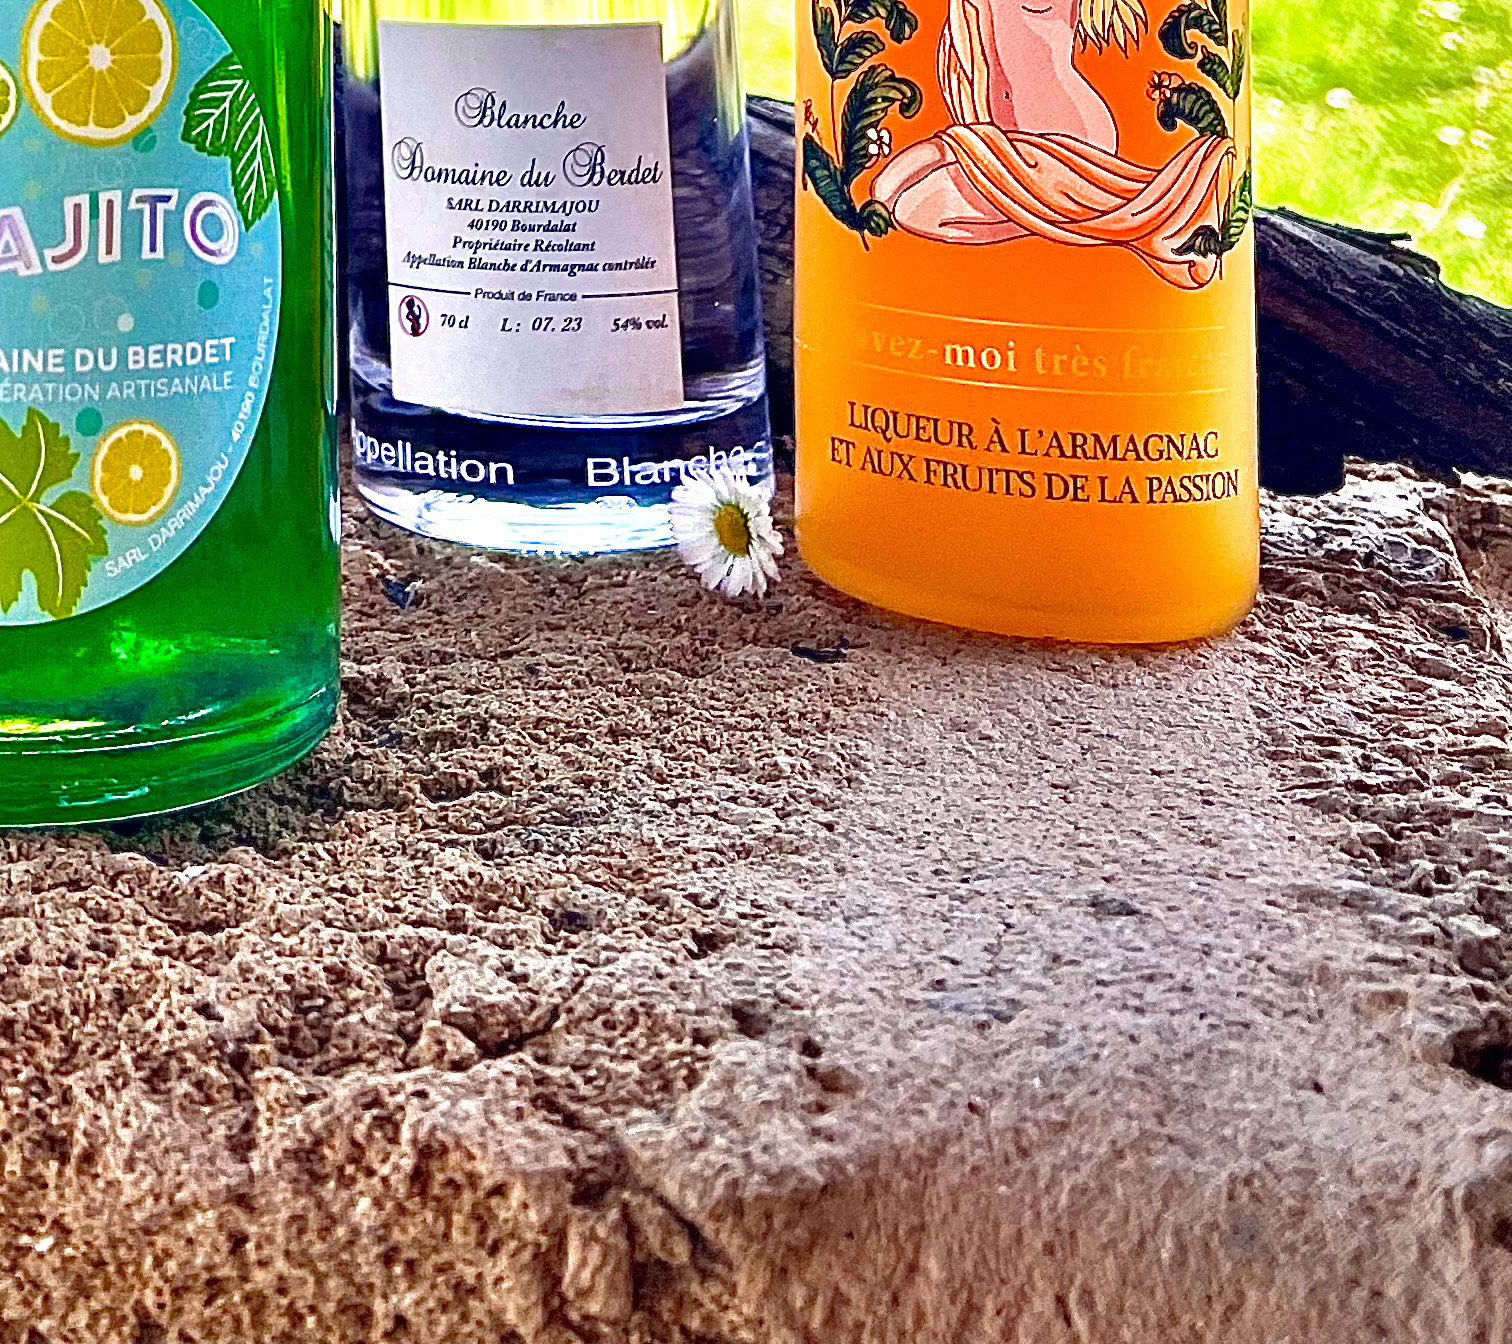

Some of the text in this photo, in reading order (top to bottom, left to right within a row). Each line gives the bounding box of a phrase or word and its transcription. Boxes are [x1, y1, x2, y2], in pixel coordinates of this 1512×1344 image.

[454, 86, 587, 130] Blanche
[391, 136, 663, 188] Domaine du Berdet
[446, 197, 600, 216] SARL DARRIMAJOU
[467, 218, 578, 233] 40190 Bourdalat
[452, 235, 596, 255] Propriétaire Récoltant
[402, 250, 465, 270] Appellation
[467, 257, 516, 272] Blanche
[520, 258, 599, 277] d'Armagnac
[474, 288, 577, 302] Produit de France
[440, 313, 456, 328] 70
[610, 316, 642, 332] 54%
[75, 346, 117, 373] DU
[127, 336, 237, 371] BERDET
[1035, 343, 1107, 378] très
[106, 370, 234, 401] ARTISANALE
[105, 545, 149, 577] SARL
[147, 452, 229, 551] DARRIMAJOU
[248, 276, 274, 388] BOURDALAT
[847, 400, 1219, 461] LIQUEUR À L'ARMAGNAC
[352, 420, 745, 487] ppellation Blanche
[830, 436, 1239, 505] ET AUX FRUITS DE LA PASSION
